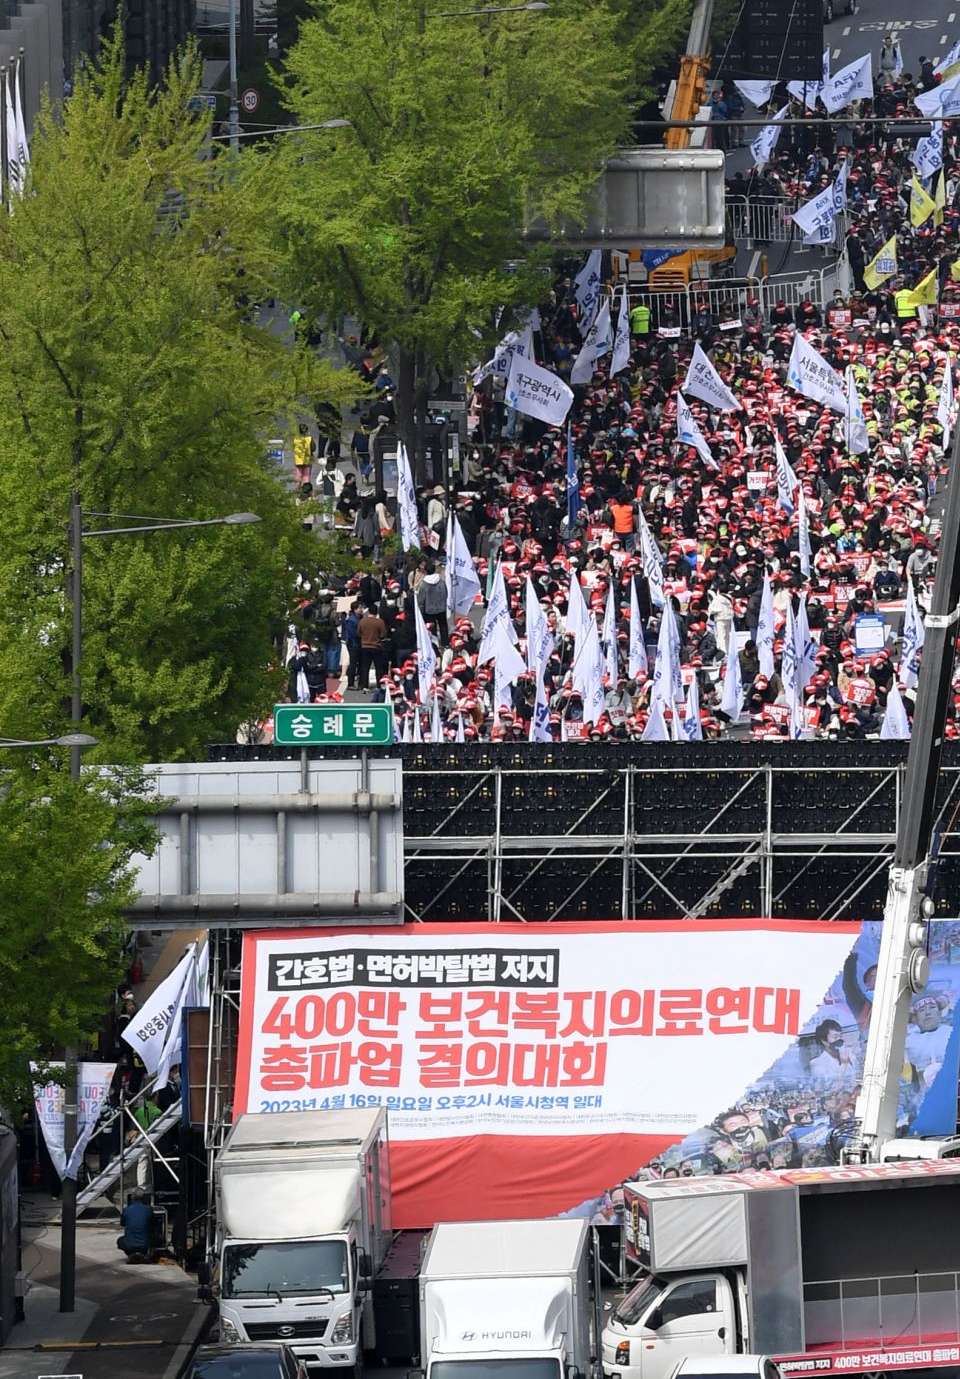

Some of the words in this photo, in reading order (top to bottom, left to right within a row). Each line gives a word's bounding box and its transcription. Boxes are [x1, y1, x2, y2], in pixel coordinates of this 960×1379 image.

[246, 96, 256, 106] 30
[290, 712, 375, 737] 숭례문
[501, 954, 555, 983] 저지
[261, 990, 407, 1040] 400만
[415, 987, 800, 1040] 보건복지의료연대
[260, 1041, 403, 1091] 총파업
[417, 1041, 608, 1088] 결의대회
[260, 1098, 317, 1114] 2023년
[320, 1095, 345, 1111] 4월
[350, 1094, 382, 1109] 16일
[386, 1096, 433, 1112] 일요일
[437, 1094, 491, 1112] 오후2시
[495, 1095, 569, 1109] 서울시청역
[573, 1095, 603, 1109] 일대
[482, 1332, 532, 1340] HYUNDAI
[834, 1355, 861, 1369] 400만
[862, 1352, 931, 1367] 보건복지의료연대
[933, 1349, 960, 1360] 총파업
